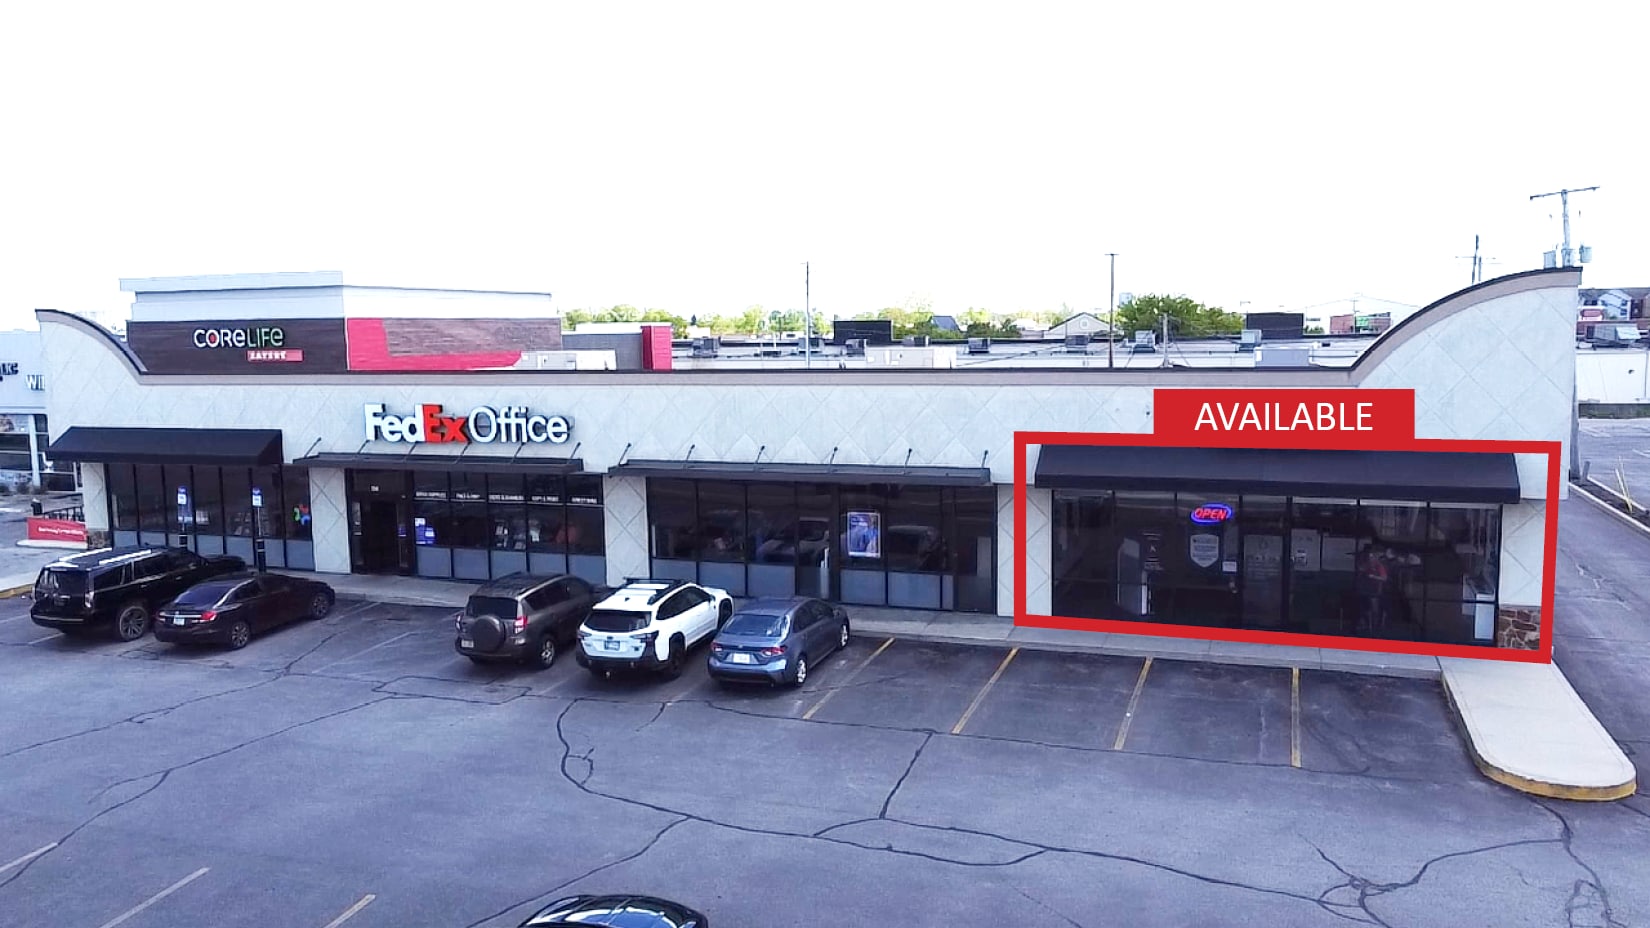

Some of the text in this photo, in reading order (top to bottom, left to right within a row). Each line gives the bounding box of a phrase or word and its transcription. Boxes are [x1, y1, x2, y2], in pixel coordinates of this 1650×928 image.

[364, 403, 569, 443] FedEx Office
[1194, 507, 1227, 520] OPEN
